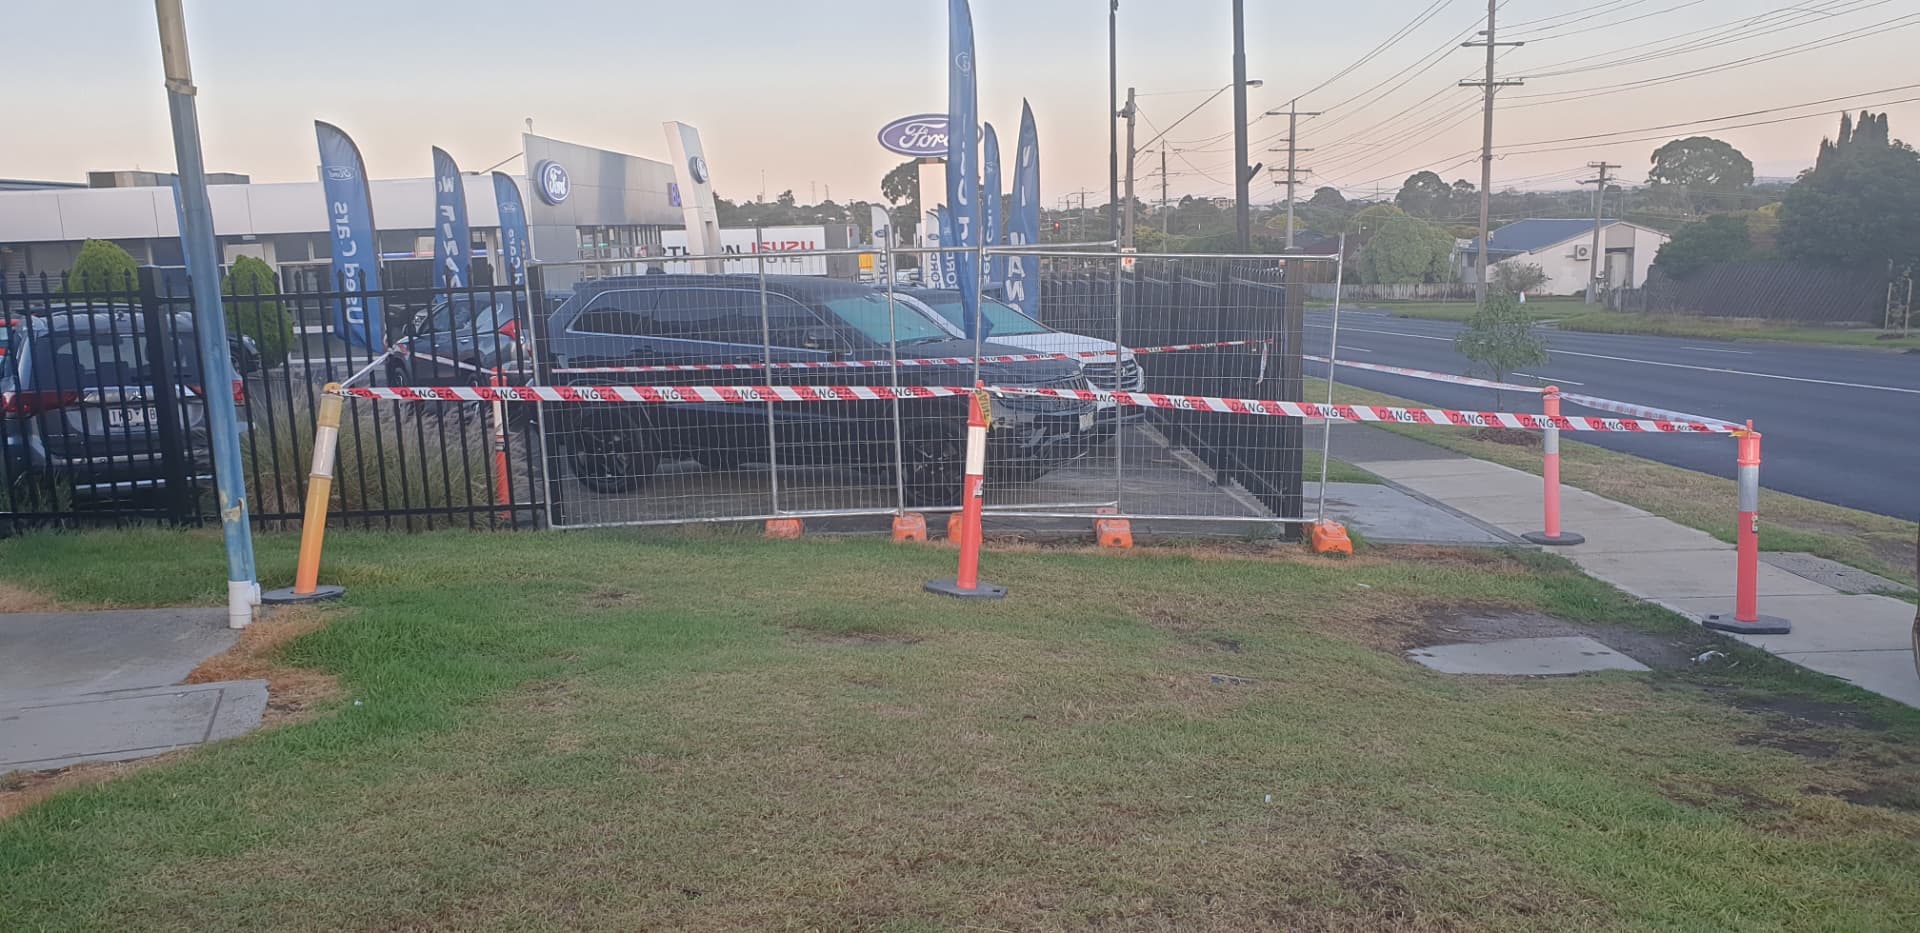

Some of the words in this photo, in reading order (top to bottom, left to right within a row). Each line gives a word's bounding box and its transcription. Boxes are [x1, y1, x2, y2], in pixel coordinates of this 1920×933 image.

[899, 121, 949, 148] For
[549, 168, 566, 195] Ford
[752, 241, 815, 254] ISUZU
[400, 388, 455, 400] DANGER
[482, 388, 535, 401] DANGER
[563, 388, 617, 401] DANGER
[643, 389, 697, 401] DANGER
[723, 388, 775, 400] DANGER
[801, 388, 852, 399] DANGER
[878, 387, 930, 398] DANGER
[1082, 393, 1133, 405] DANGER
[1157, 397, 1206, 409] DANGER
[1231, 402, 1280, 414] DANGER
[1305, 405, 1355, 418] DANGER
[1379, 410, 1428, 422] DANGER
[1451, 413, 1499, 425] DANGER
[1523, 417, 1570, 430] DANGER
[1593, 421, 1639, 432] DANGER
